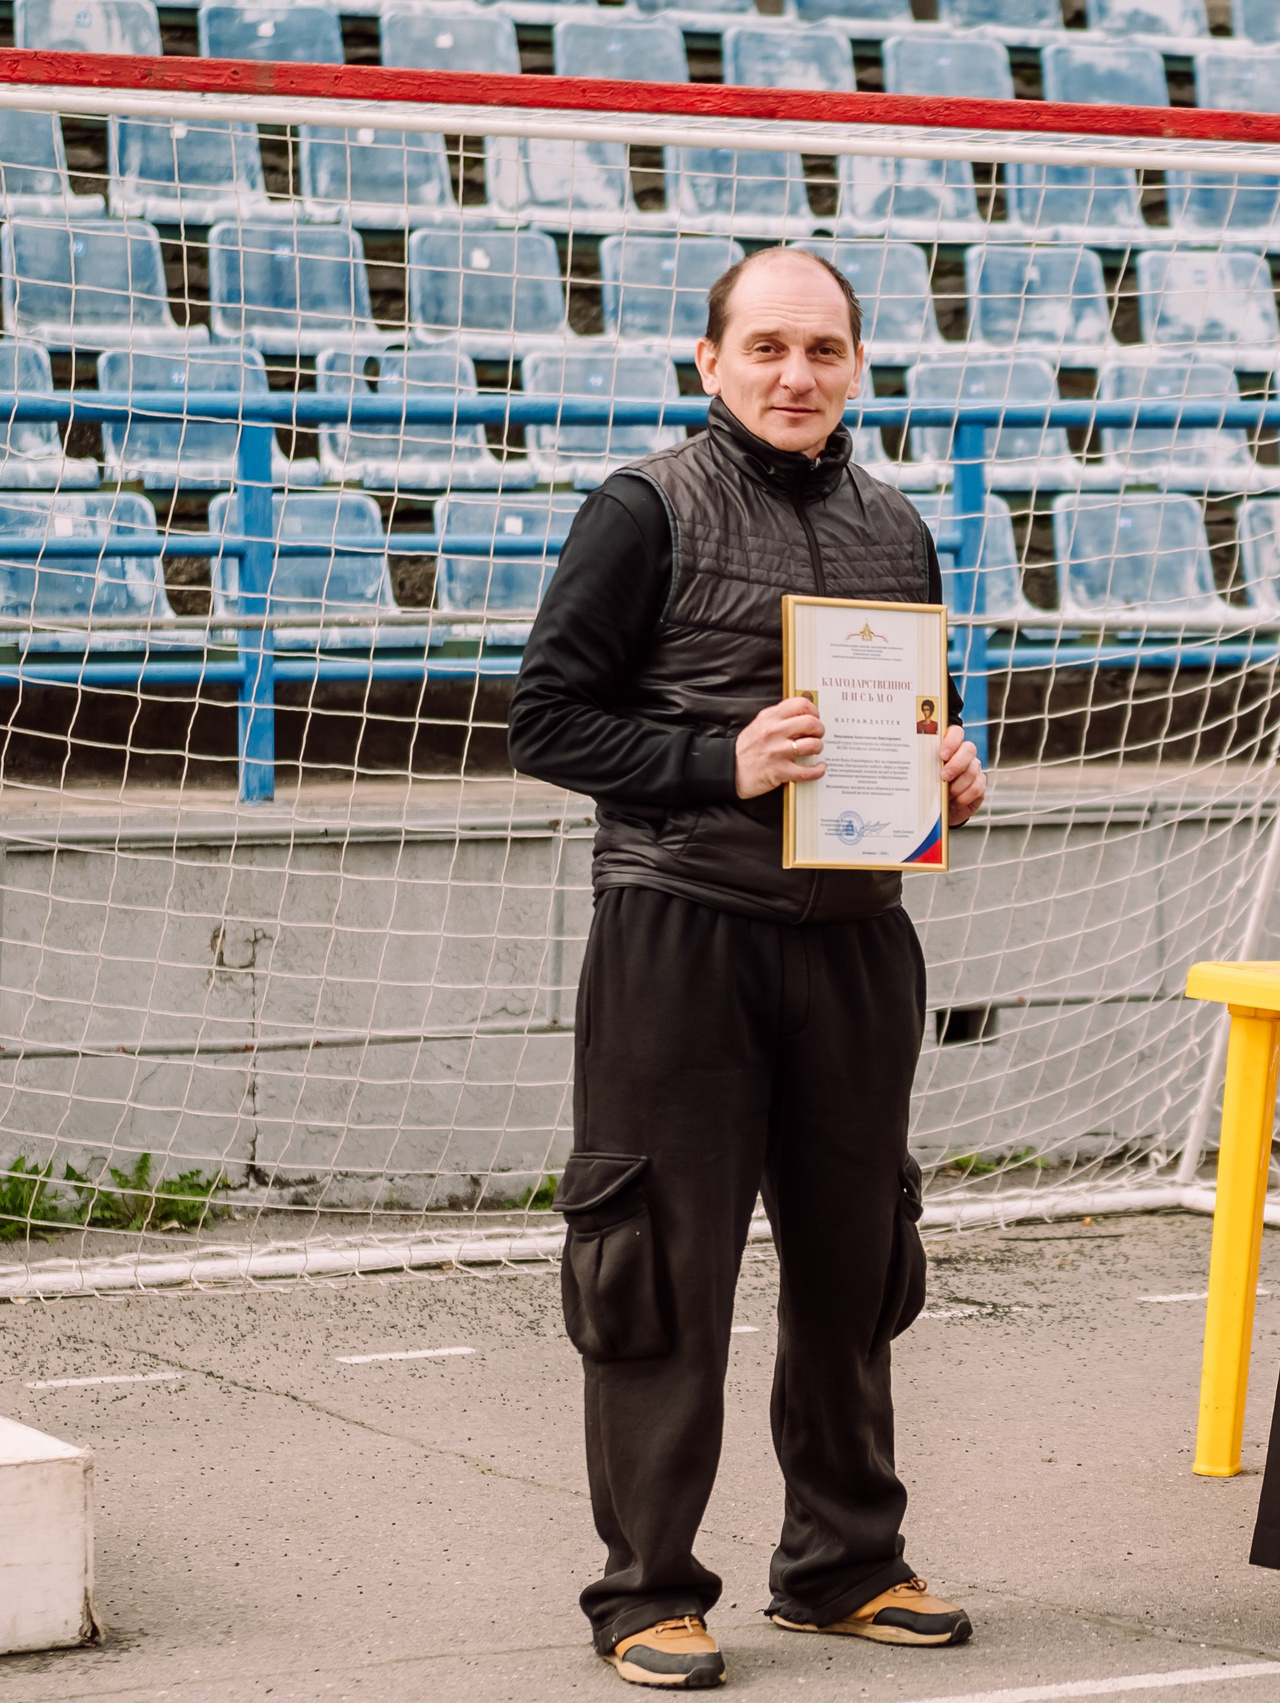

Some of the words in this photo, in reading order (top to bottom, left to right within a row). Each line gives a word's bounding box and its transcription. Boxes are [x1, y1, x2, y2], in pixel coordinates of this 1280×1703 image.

[821, 677, 913, 691] БЛАГОДАРСТВЕННОЕ
[841, 691, 894, 703] ПИСЬМО
[834, 717, 901, 726] НАГРАЖДАЕТСЯ
